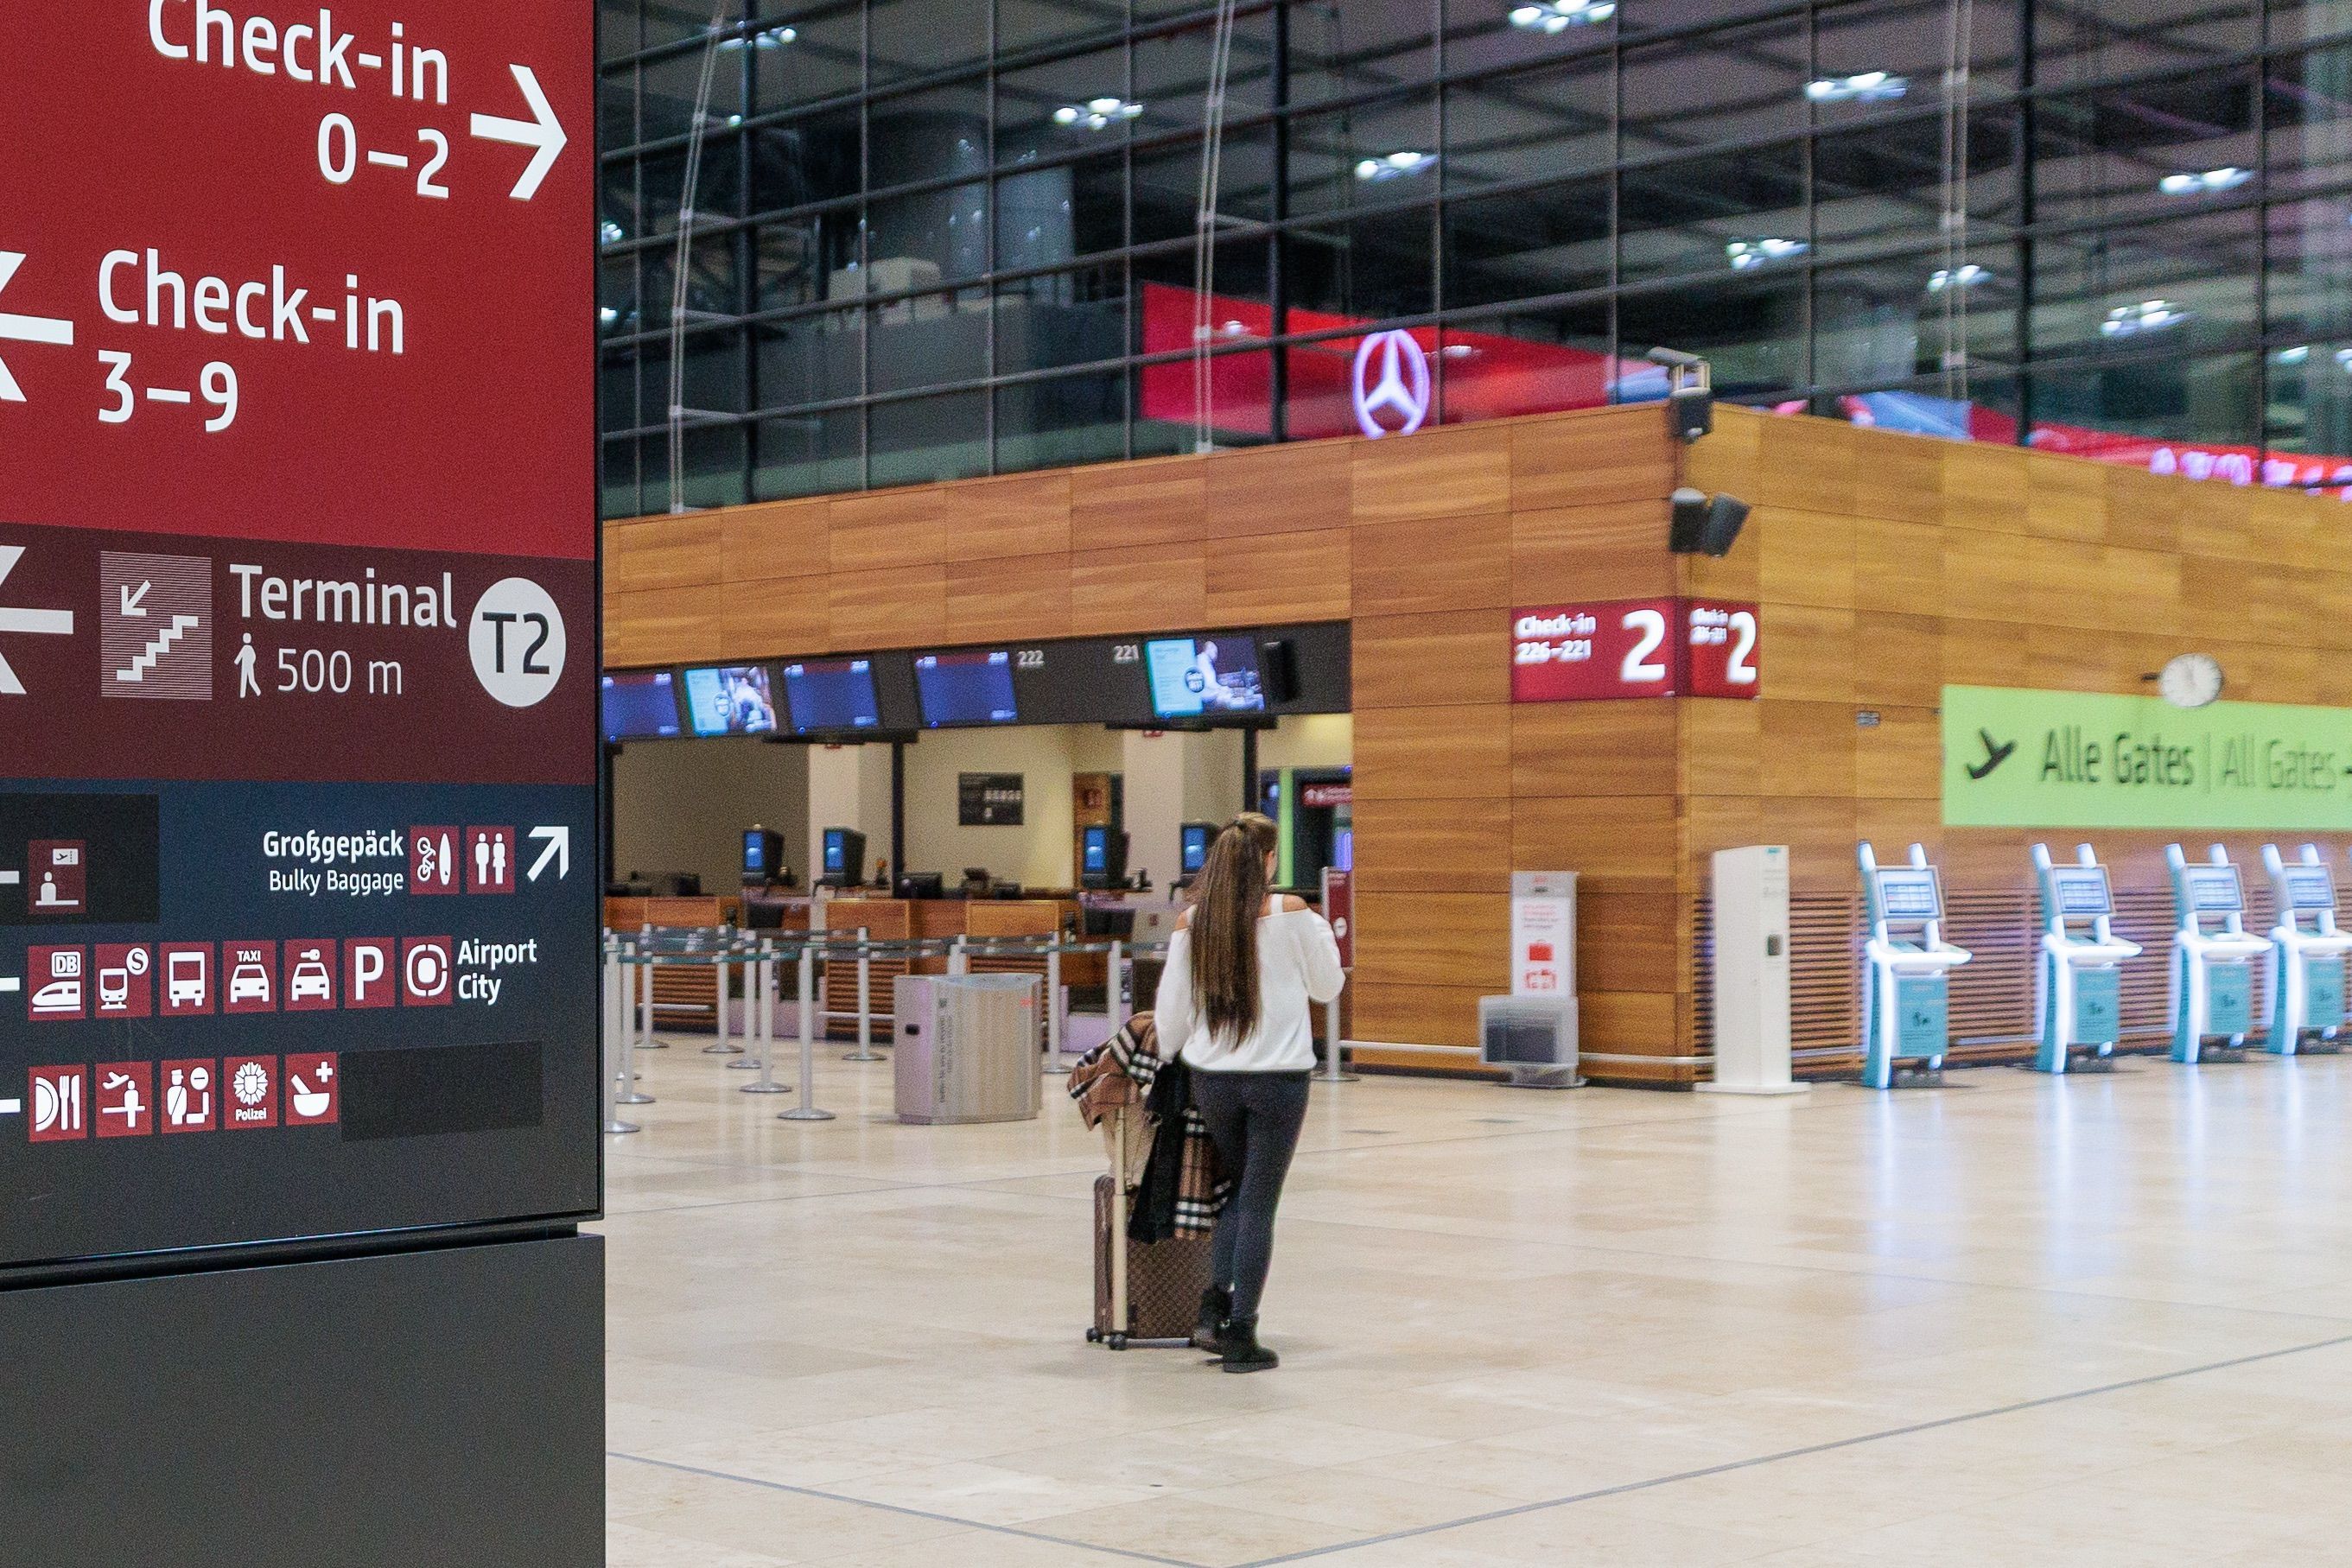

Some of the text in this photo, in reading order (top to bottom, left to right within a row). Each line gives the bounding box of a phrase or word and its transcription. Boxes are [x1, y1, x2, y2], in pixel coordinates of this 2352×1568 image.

[148, 0, 448, 105] Check-in
[98, 247, 404, 354] Check-in
[229, 564, 458, 629] Terminal
[481, 612, 550, 676] T2
[1515, 612, 1597, 638] Check-in
[1620, 608, 1666, 682] 2
[1018, 650, 1045, 669] 222
[1113, 644, 1140, 664] 221
[1727, 611, 1757, 683] 2
[277, 648, 403, 695] 500 m
[2039, 724, 2336, 790] Alle Gates All Gates
[263, 829, 405, 864] Großgepäck
[269, 868, 404, 897] Bulky Baggage
[236, 950, 262, 962] TAXI
[354, 945, 385, 1000] P
[456, 937, 537, 970] Airport
[458, 972, 502, 1006] City
[235, 1108, 267, 1121] Polizei
